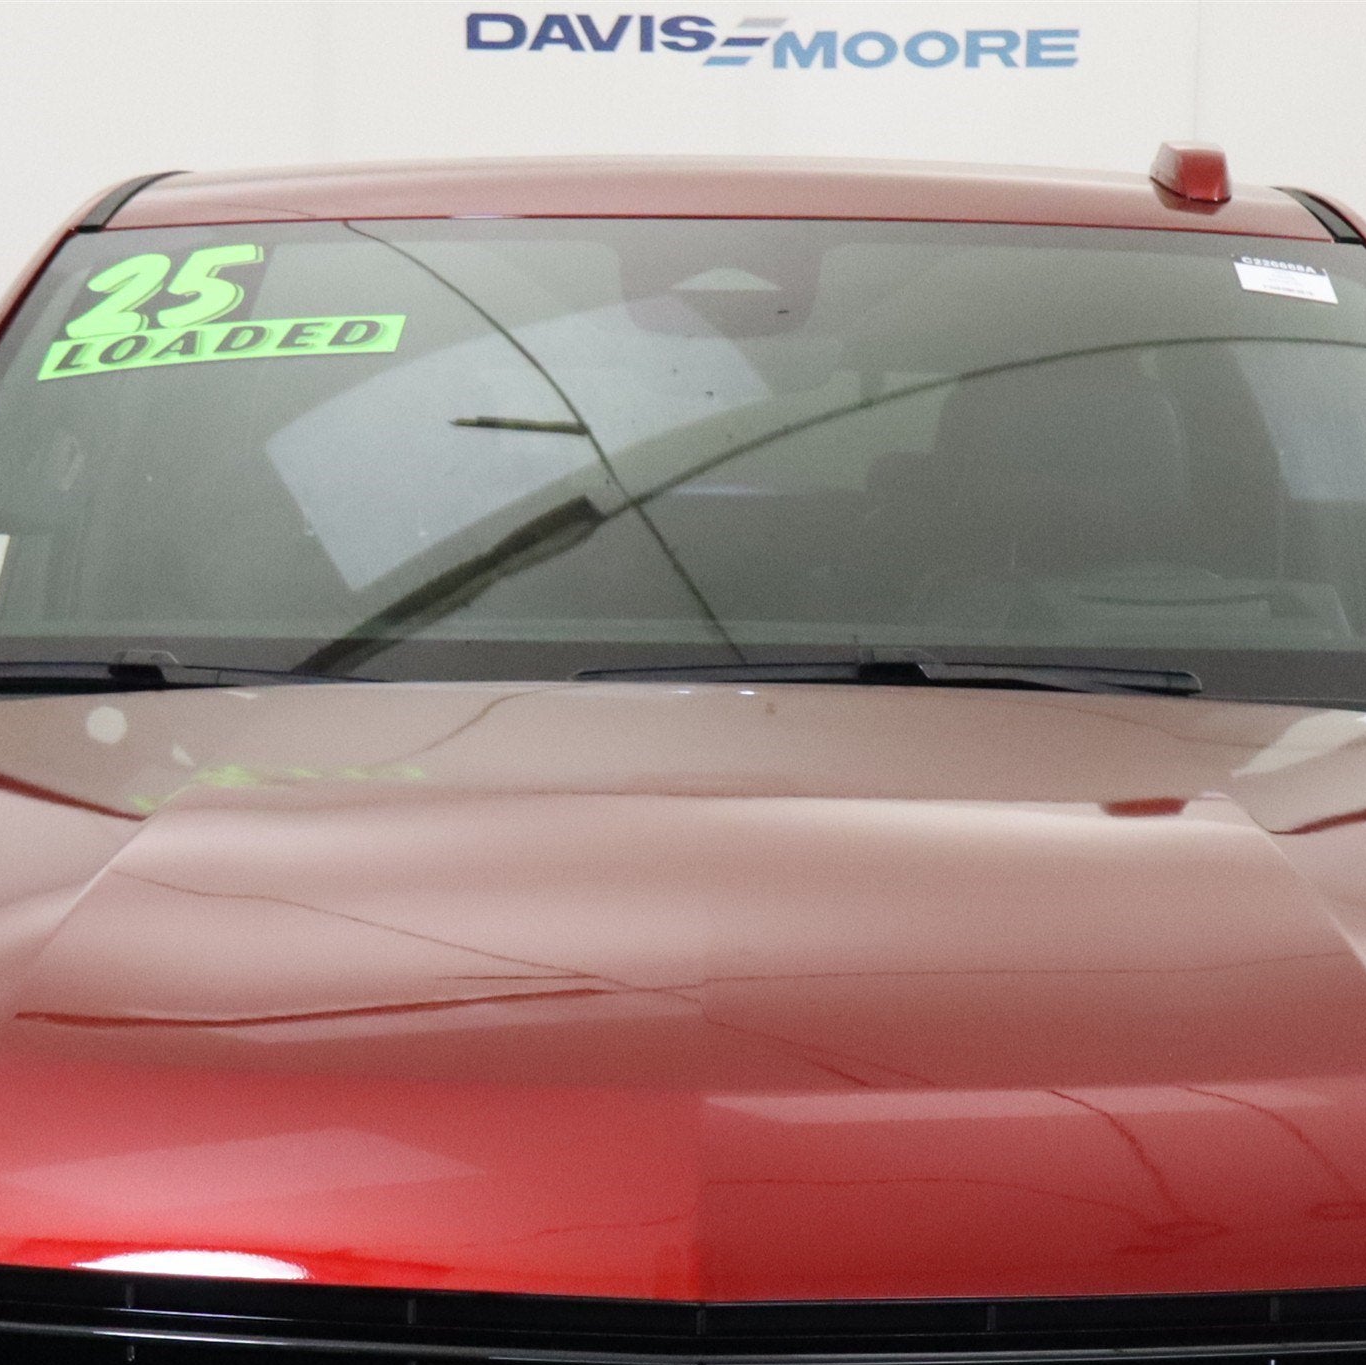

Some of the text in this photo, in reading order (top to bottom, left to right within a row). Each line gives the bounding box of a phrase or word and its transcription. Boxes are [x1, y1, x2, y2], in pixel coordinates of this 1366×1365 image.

[466, 13, 1080, 70] DAVIS MOORE
[65, 243, 264, 340] 25
[52, 319, 389, 373] LOADED
